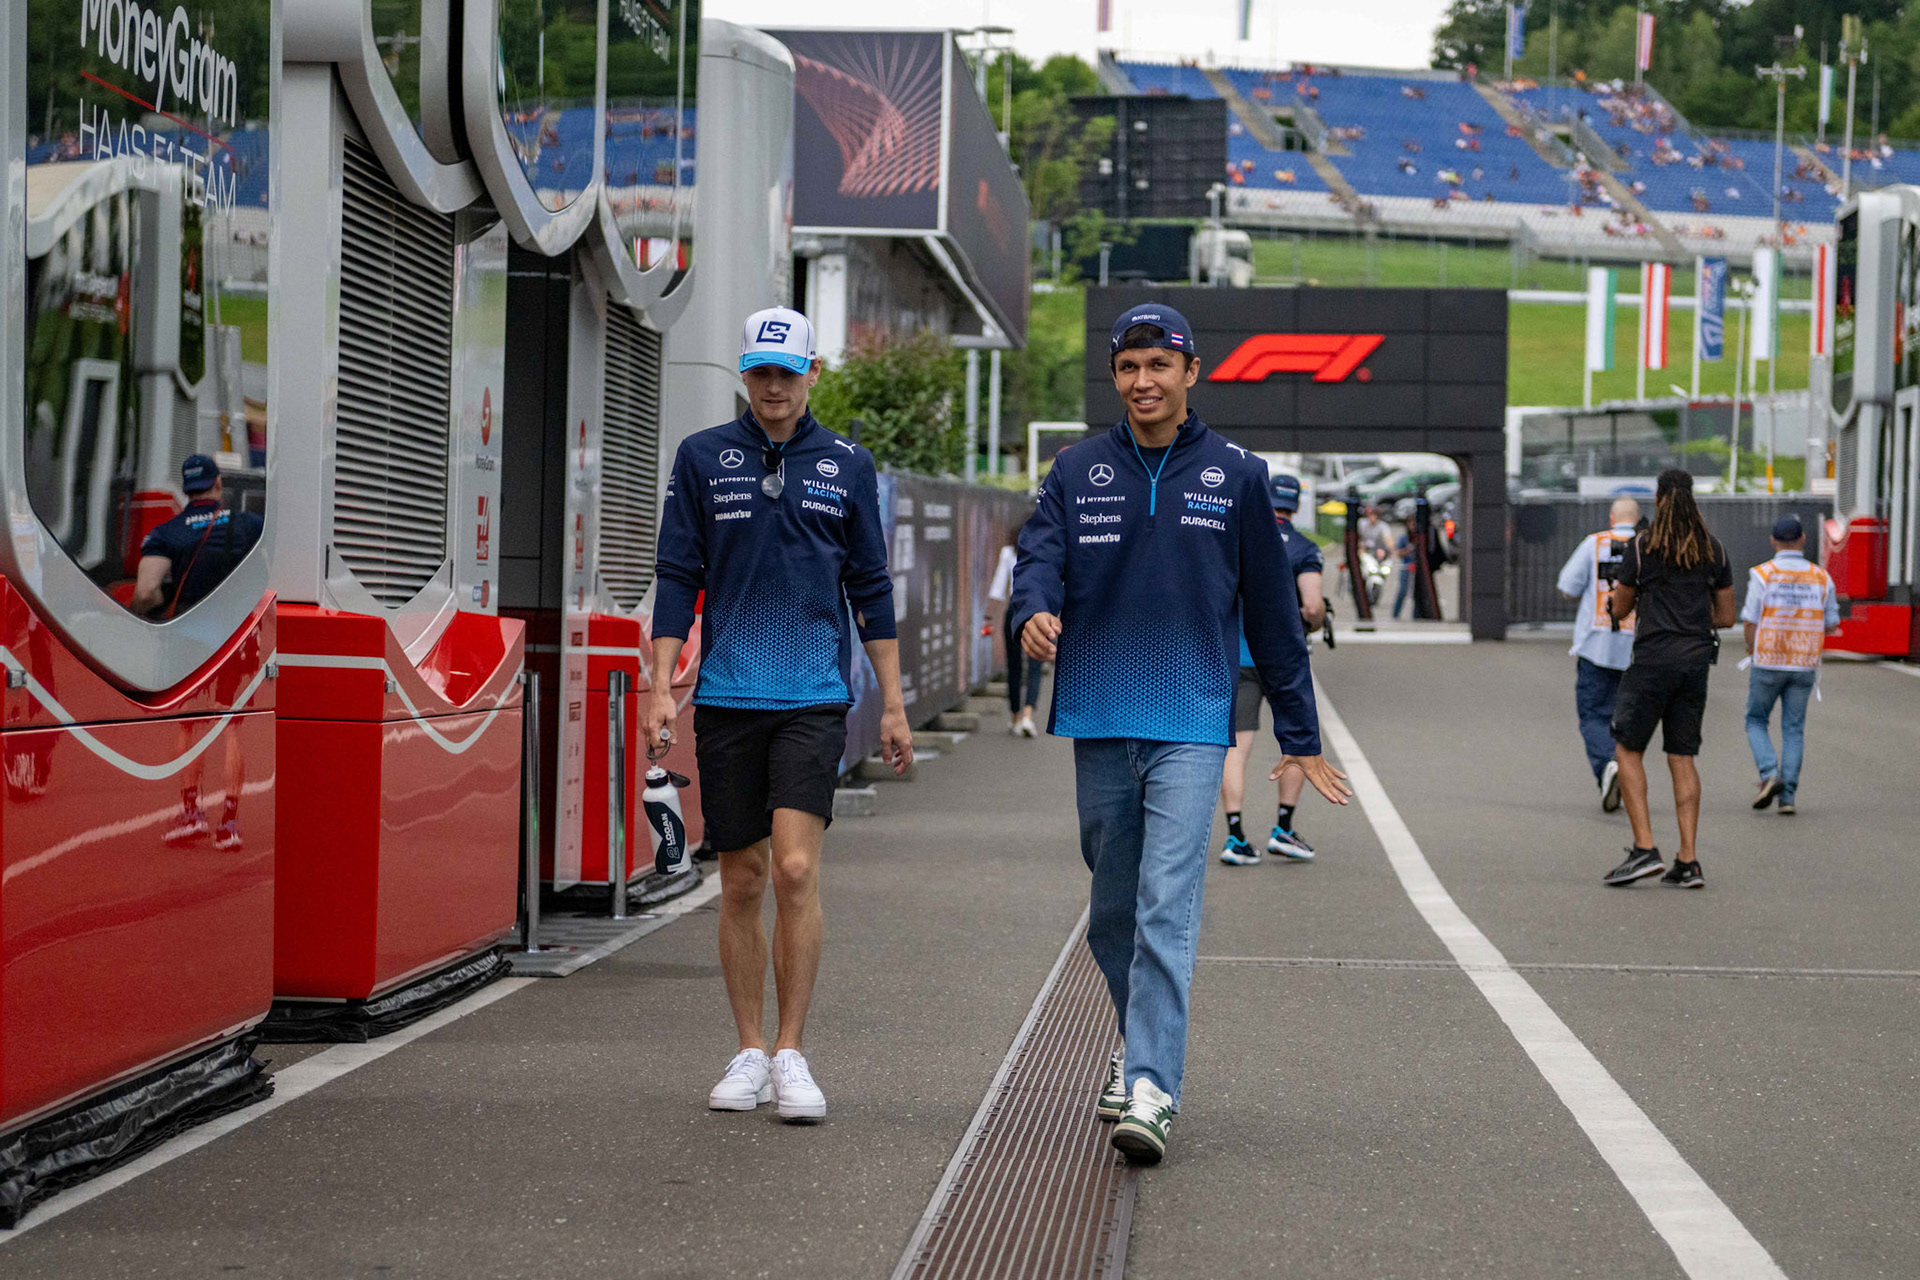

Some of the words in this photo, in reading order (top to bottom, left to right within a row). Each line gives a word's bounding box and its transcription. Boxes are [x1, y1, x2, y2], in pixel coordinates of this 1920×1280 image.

[80, 0, 238, 128] MoneyGram
[79, 98, 147, 181] HAAS
[153, 133, 174, 192] F1
[180, 146, 237, 220] TEAM
[755, 320, 792, 344] LS
[1207, 333, 1385, 382] F1
[802, 480, 847, 497] WILLIAMS
[807, 487, 841, 501] RACING
[713, 492, 752, 503] Stephens
[1087, 495, 1126, 503] MYPROTEIN
[1184, 492, 1233, 507] WILLIAMS
[715, 510, 751, 520] KOMATSU
[802, 500, 843, 517] DURACELL
[1187, 501, 1226, 514] RACING
[1080, 513, 1122, 525] Stephens
[1181, 516, 1226, 531] DURACELL
[1079, 533, 1121, 543] KOMATSU
[661, 813, 673, 846] LOGAN
